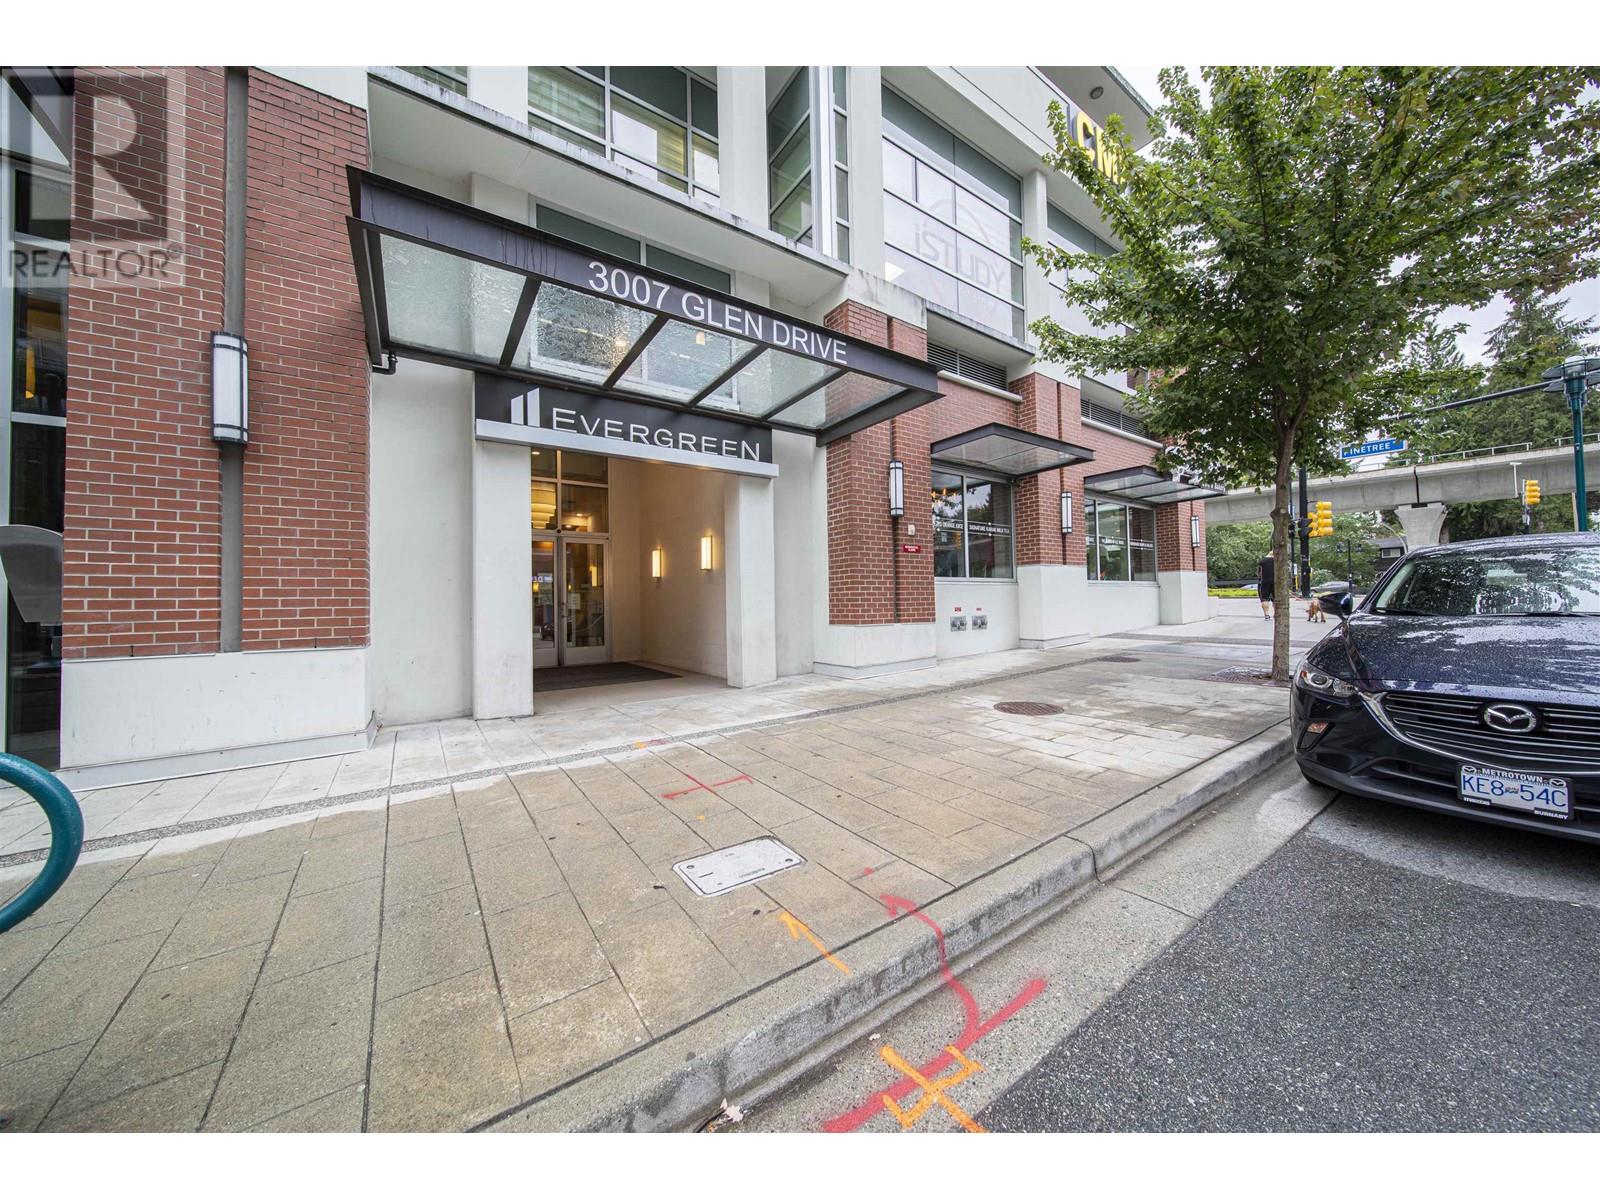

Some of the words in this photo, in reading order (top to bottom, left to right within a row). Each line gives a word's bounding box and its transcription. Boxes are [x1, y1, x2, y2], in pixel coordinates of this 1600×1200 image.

[1076, 111, 1126, 185] CM
[914, 223, 1006, 294] iSTUDY
[588, 261, 670, 309] 3007
[681, 292, 763, 340] GLEN
[772, 320, 848, 365] DRIVE
[552, 407, 760, 461] EVERGREEN
[1344, 442, 1391, 456] INETREE
[1463, 774, 1505, 796] KE8
[1520, 784, 1566, 807] 54C
[1482, 768, 1543, 783] METROTOWN
[1534, 809, 1568, 820] BURNABY
